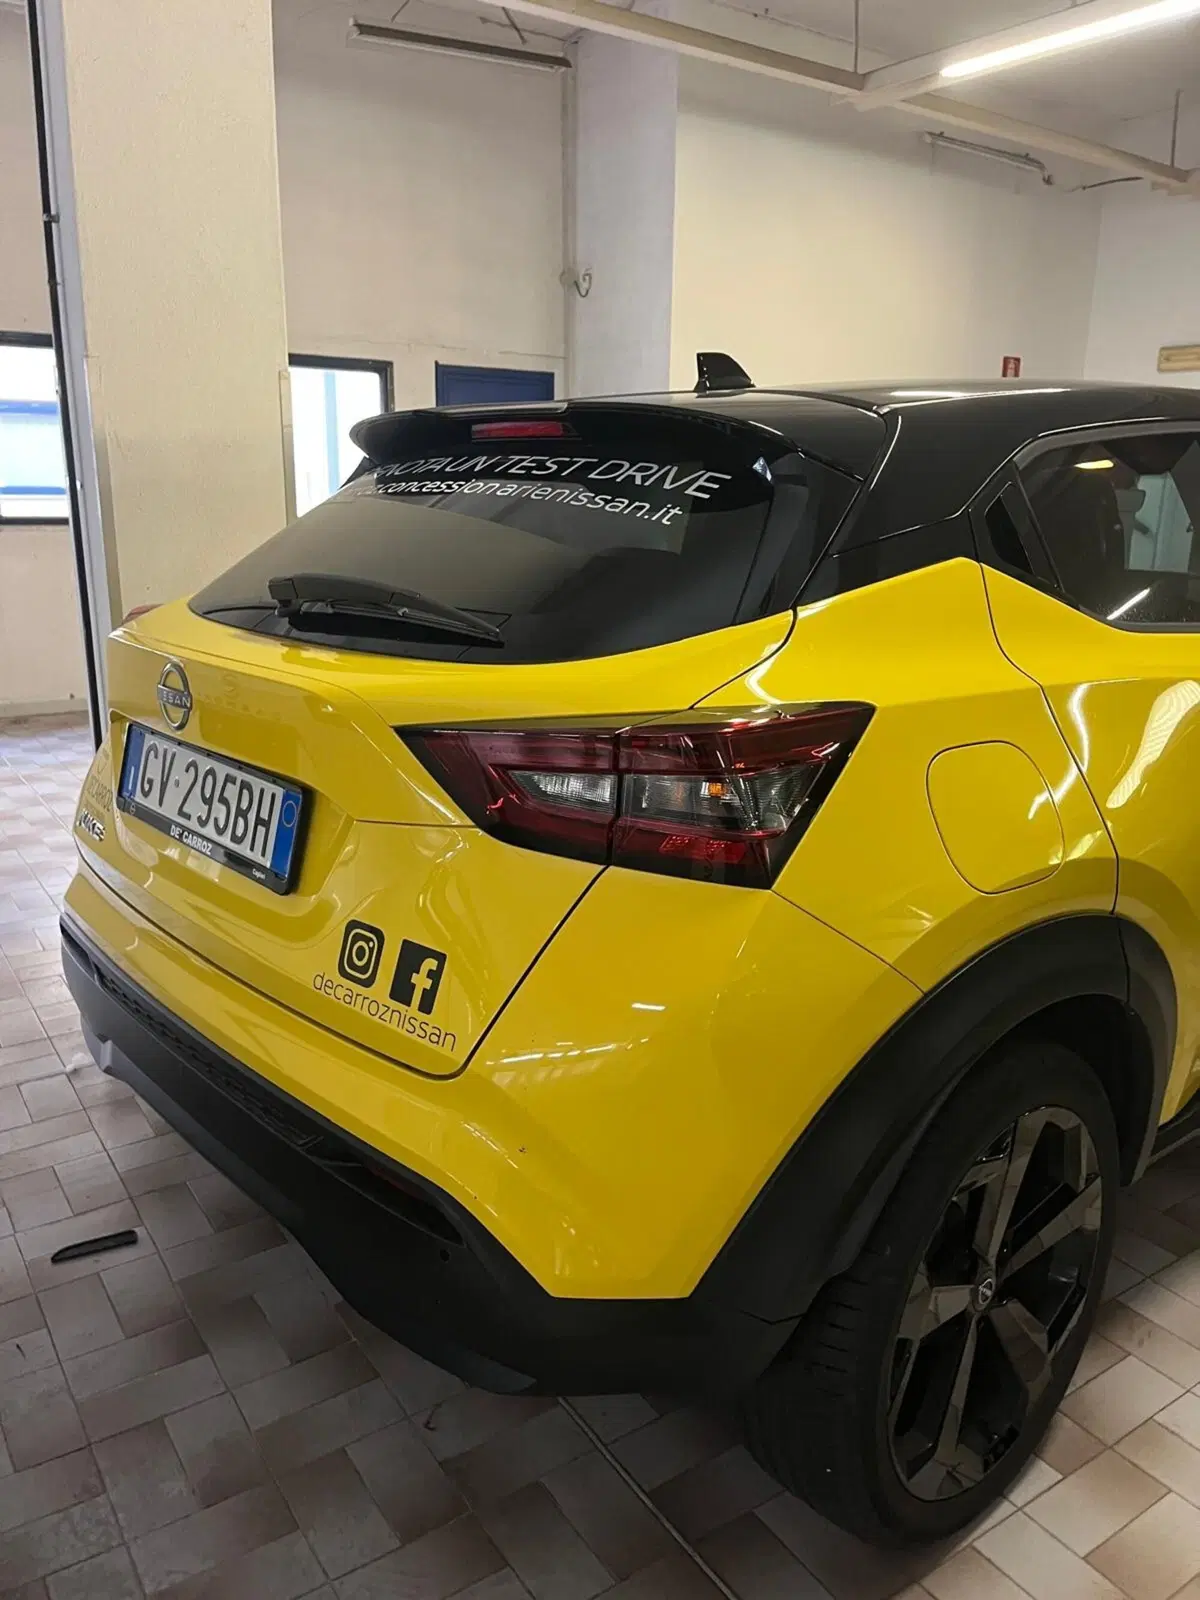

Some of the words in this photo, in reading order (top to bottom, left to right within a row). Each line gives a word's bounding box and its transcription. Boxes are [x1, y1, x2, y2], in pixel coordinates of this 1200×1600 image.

[445, 456, 502, 472] UN
[495, 456, 598, 476] TEST
[588, 460, 732, 499] DRIVE
[183, 831, 213, 855] CARROZ
[312, 972, 457, 1052] decarroznissan
